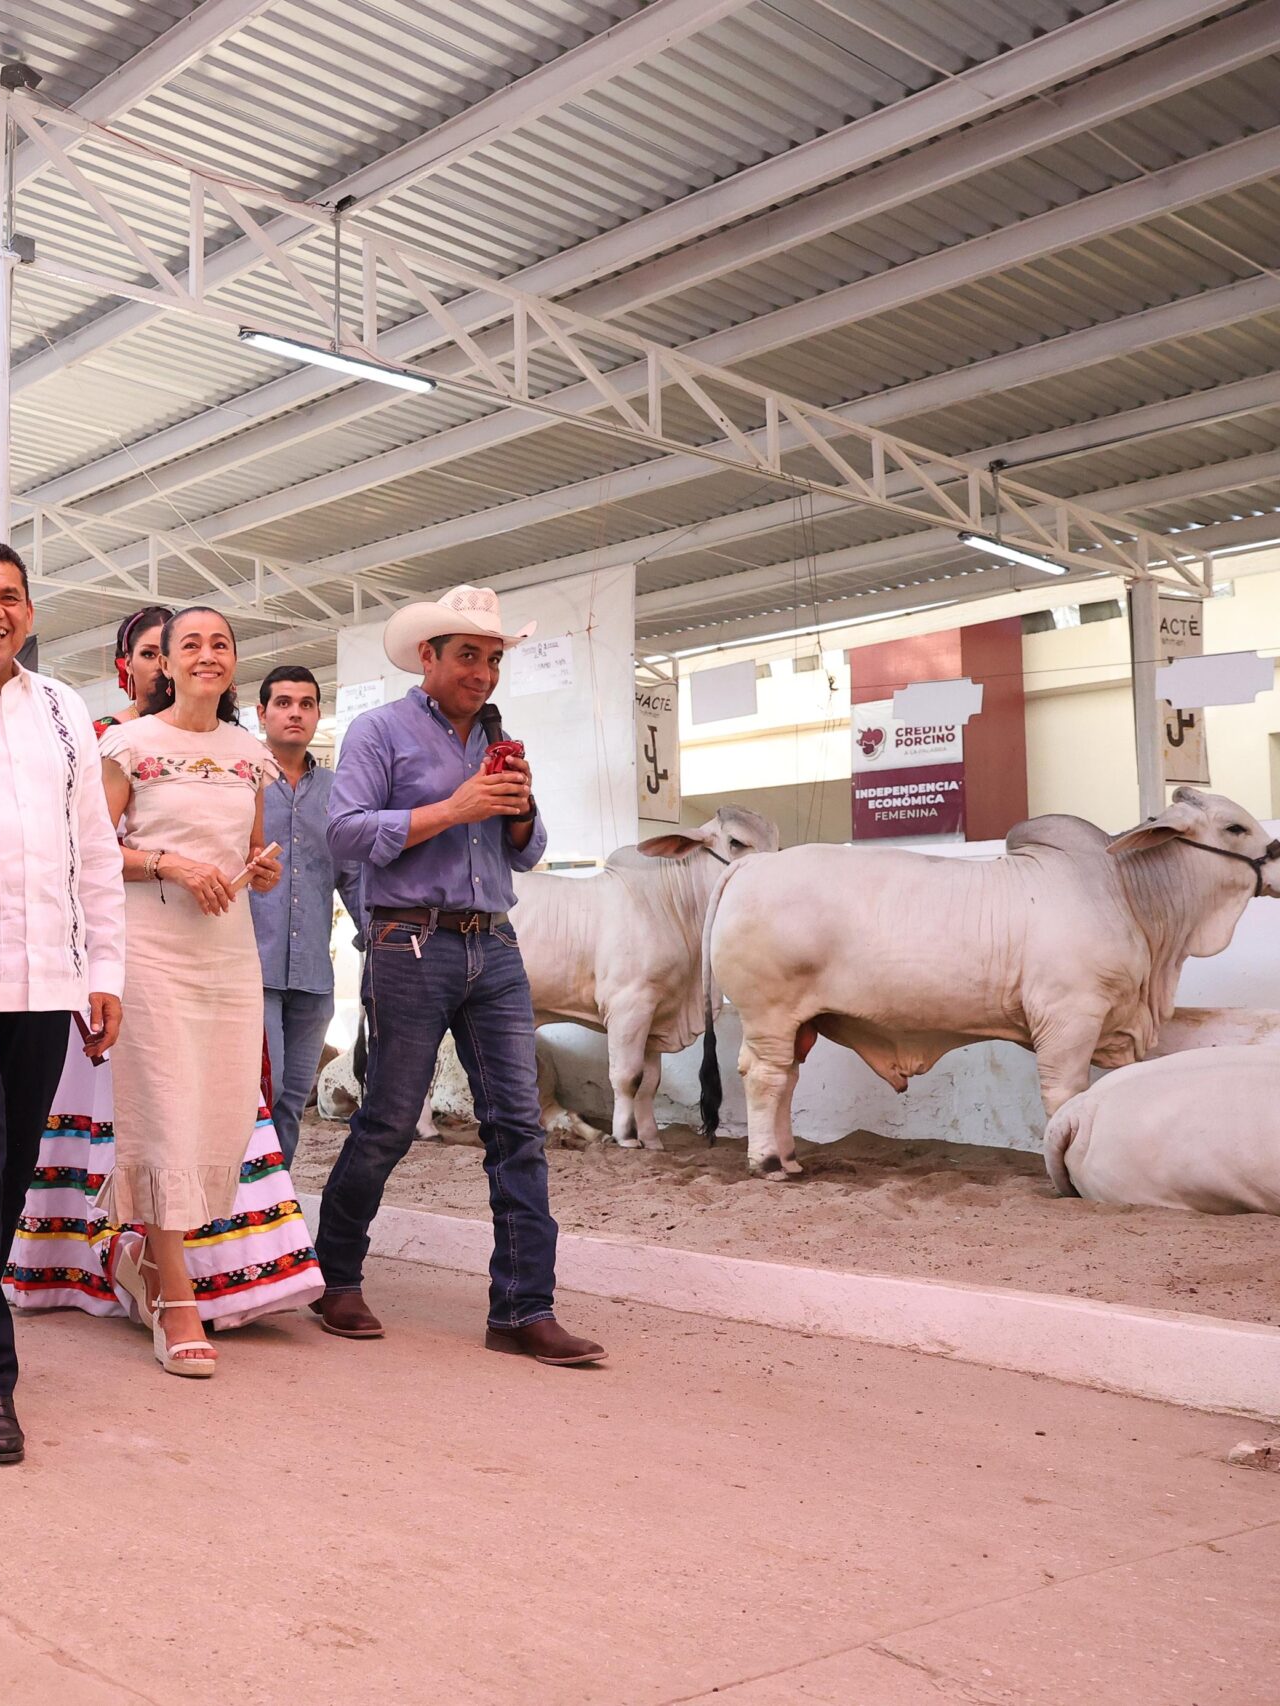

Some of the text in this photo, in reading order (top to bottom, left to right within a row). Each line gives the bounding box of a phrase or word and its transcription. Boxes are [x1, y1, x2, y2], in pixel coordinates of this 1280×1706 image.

[1159, 614, 1201, 636] ACTÉ
[895, 732, 956, 748] PORCINO
[855, 781, 959, 799] INDEPENDENCIA
[868, 793, 945, 809] ECONÓMICA
[875, 808, 938, 821] FEMENINA
